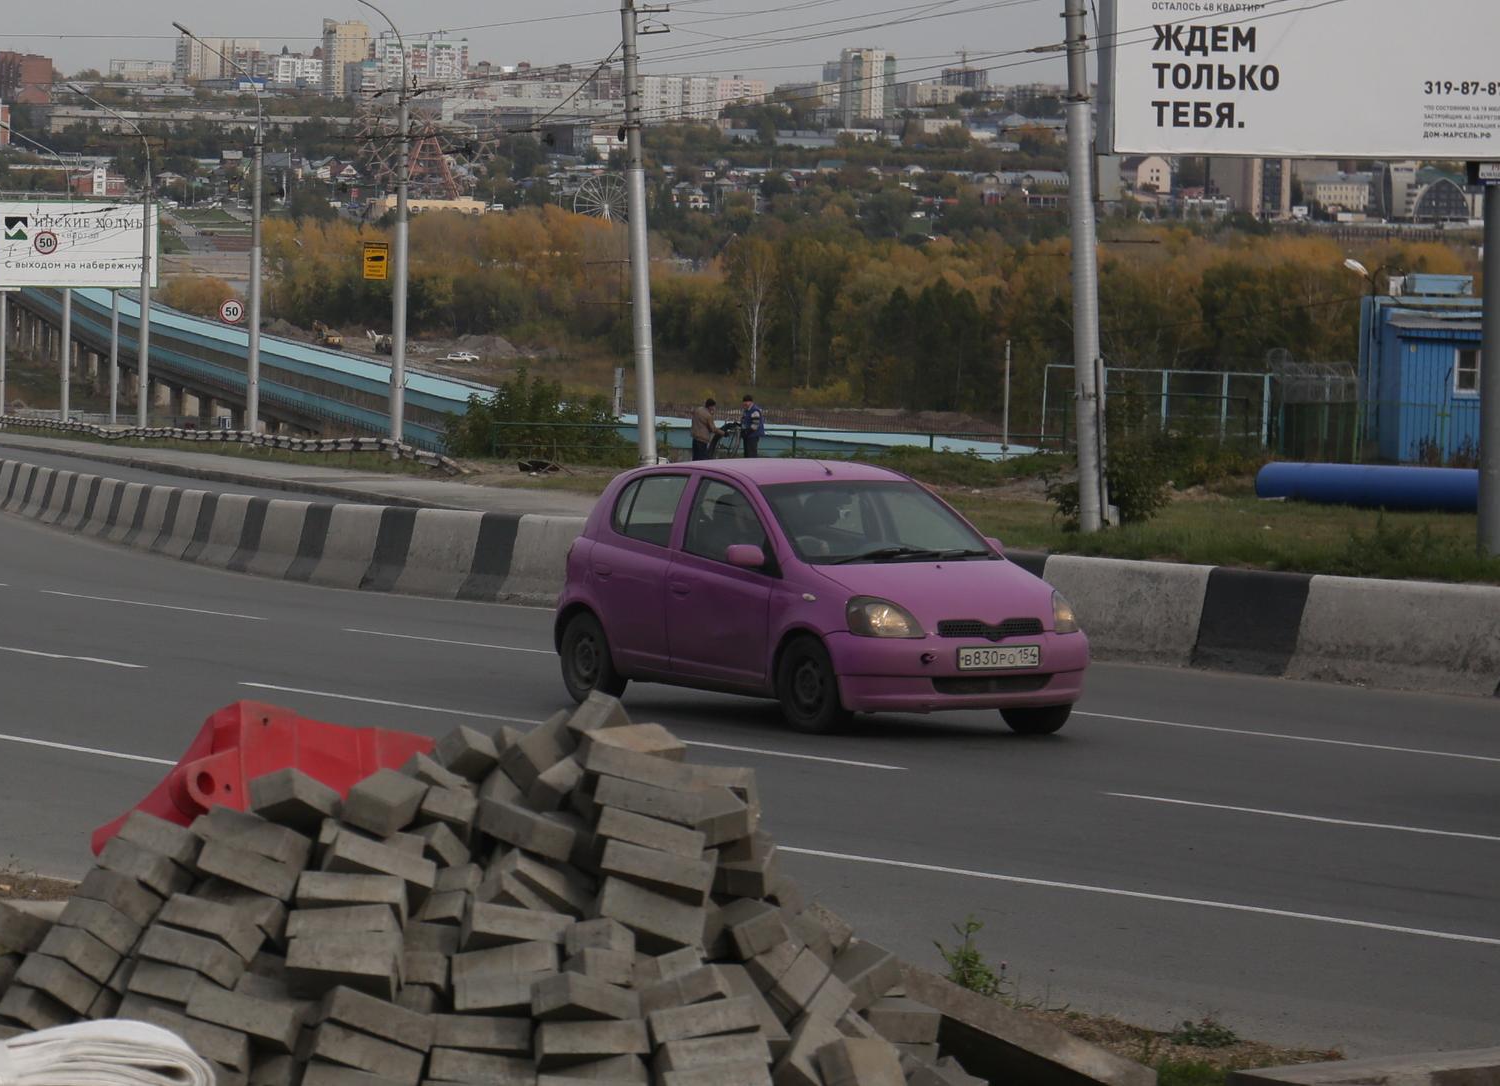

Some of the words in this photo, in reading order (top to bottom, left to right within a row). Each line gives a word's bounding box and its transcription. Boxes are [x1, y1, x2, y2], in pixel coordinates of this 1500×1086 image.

[1151, 2, 1201, 11] ОСТАЛОСЬ
[1203, 3, 1214, 11] 48
[1151, 24, 1256, 57] ЖДЕМ
[1152, 62, 1280, 91] ТОЛЬКО
[1151, 100, 1245, 129] ТЕБЯ.
[39, 237, 52, 248] 50
[4, 260, 12, 269] С
[15, 261, 61, 270] выходом
[225, 306, 239, 317] 50
[964, 650, 1016, 666] В830РО
[1018, 647, 1037, 660] 154
